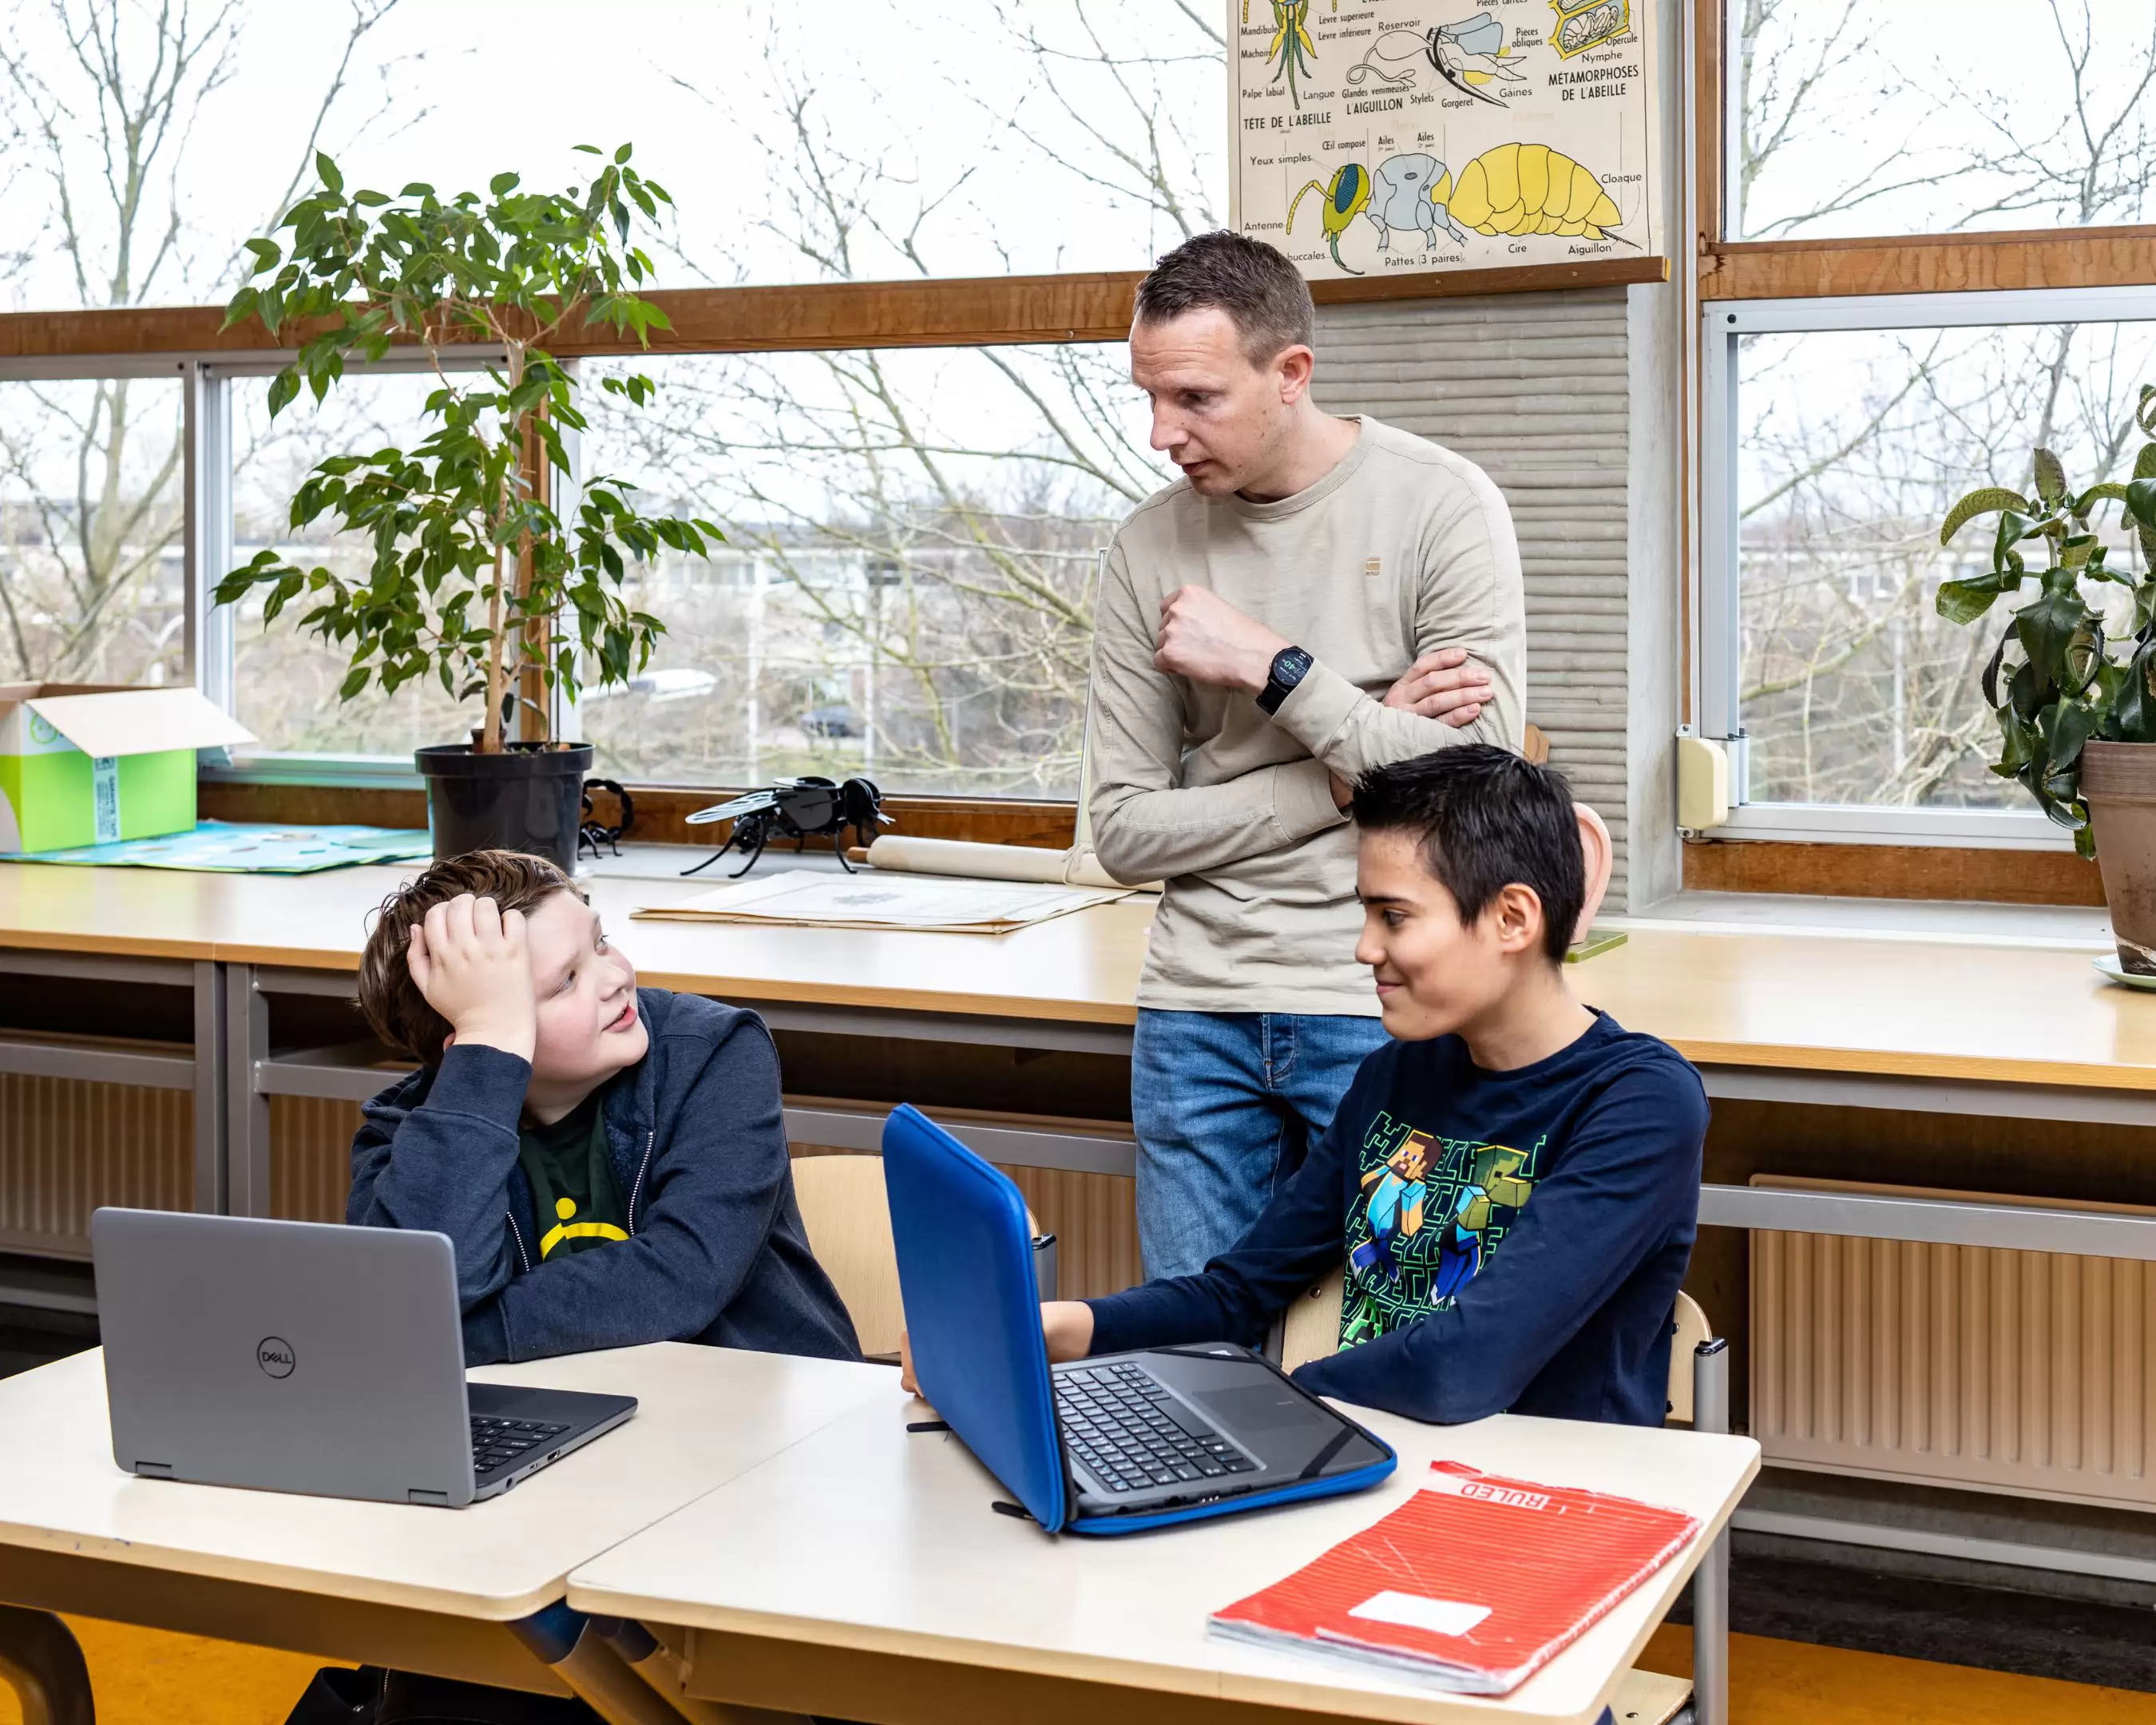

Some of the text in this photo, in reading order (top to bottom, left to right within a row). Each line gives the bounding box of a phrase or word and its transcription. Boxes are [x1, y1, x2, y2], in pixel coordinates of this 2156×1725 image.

[1241, 25, 1278, 36] Mandibule
[1512, 38, 1543, 48] obliques
[1606, 35, 1638, 46] Opercule
[1582, 50, 1623, 64] Nymphe
[1548, 64, 1639, 85] MÉTAMORPHOSES
[1242, 86, 1285, 99] Palpe labial
[1303, 90, 1335, 101] Langue
[1342, 84, 1409, 98] Glandes venimeuses
[1500, 87, 1532, 97] Gaines
[1562, 83, 1626, 101] DE L'ABEILLE
[1410, 93, 1434, 105] Stylets
[1441, 97, 1473, 109] Gorgeret
[1347, 97, 1403, 115] L'AIGUILLON
[1271, 117, 1283, 128] DE
[1289, 112, 1331, 126] L'ABEILLE
[1378, 135, 1394, 145] Ailes
[1417, 132, 1434, 142] Ailes
[1250, 153, 1312, 165] Yeux simples
[1601, 173, 1642, 184] Cloaque
[1244, 222, 1284, 231] Antenne
[1508, 243, 1527, 253] Cire
[1568, 243, 1611, 256] Aiguillon
[1286, 251, 1326, 261] buccales
[1385, 256, 1414, 267] Pattes
[262, 1351, 292, 1364] DELL
[1460, 1483, 1544, 1508] RULED
